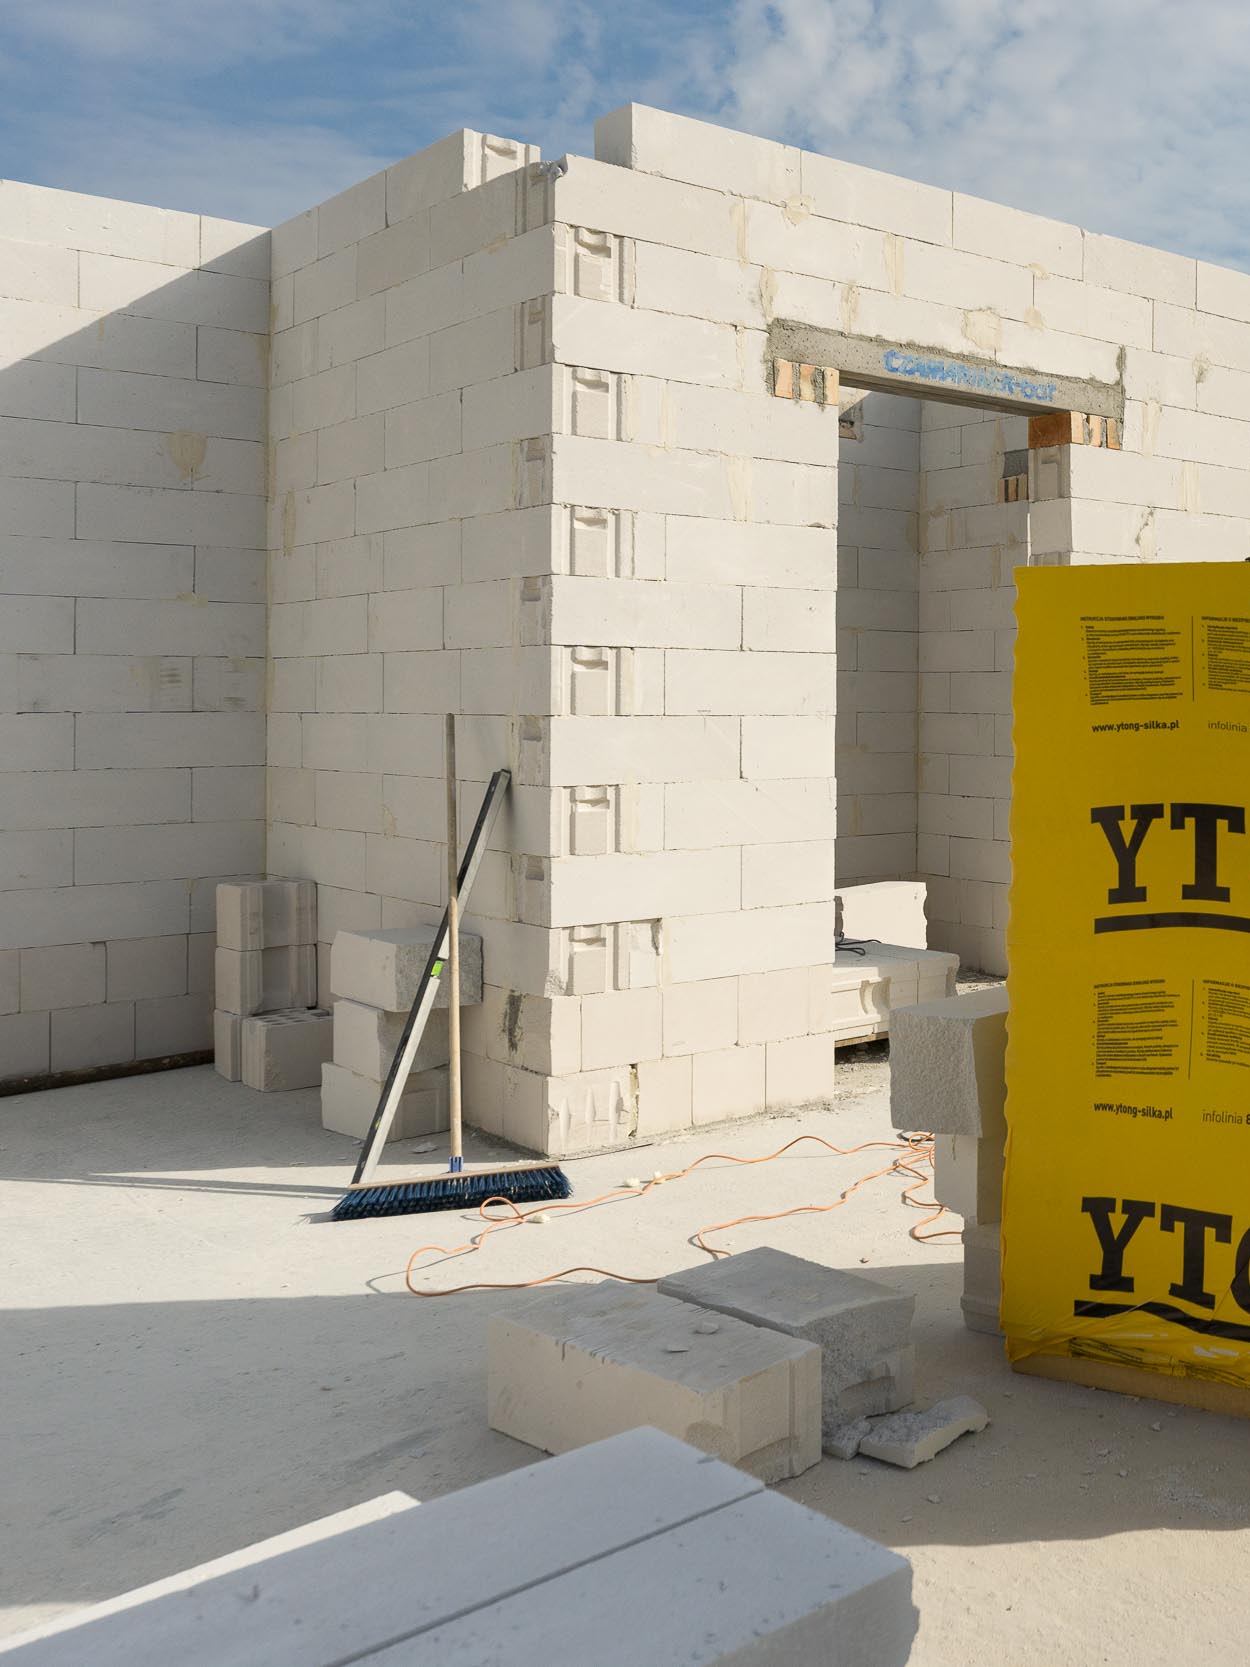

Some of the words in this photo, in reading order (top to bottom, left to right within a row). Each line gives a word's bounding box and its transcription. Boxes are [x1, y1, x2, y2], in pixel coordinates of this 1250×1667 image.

[1092, 720, 1179, 732] www.ytong-silka.pl
[1207, 720, 1247, 733] infolinia
[1093, 1102, 1174, 1121] www.ytong-silka.pl
[1202, 1109, 1243, 1125] infolinia
